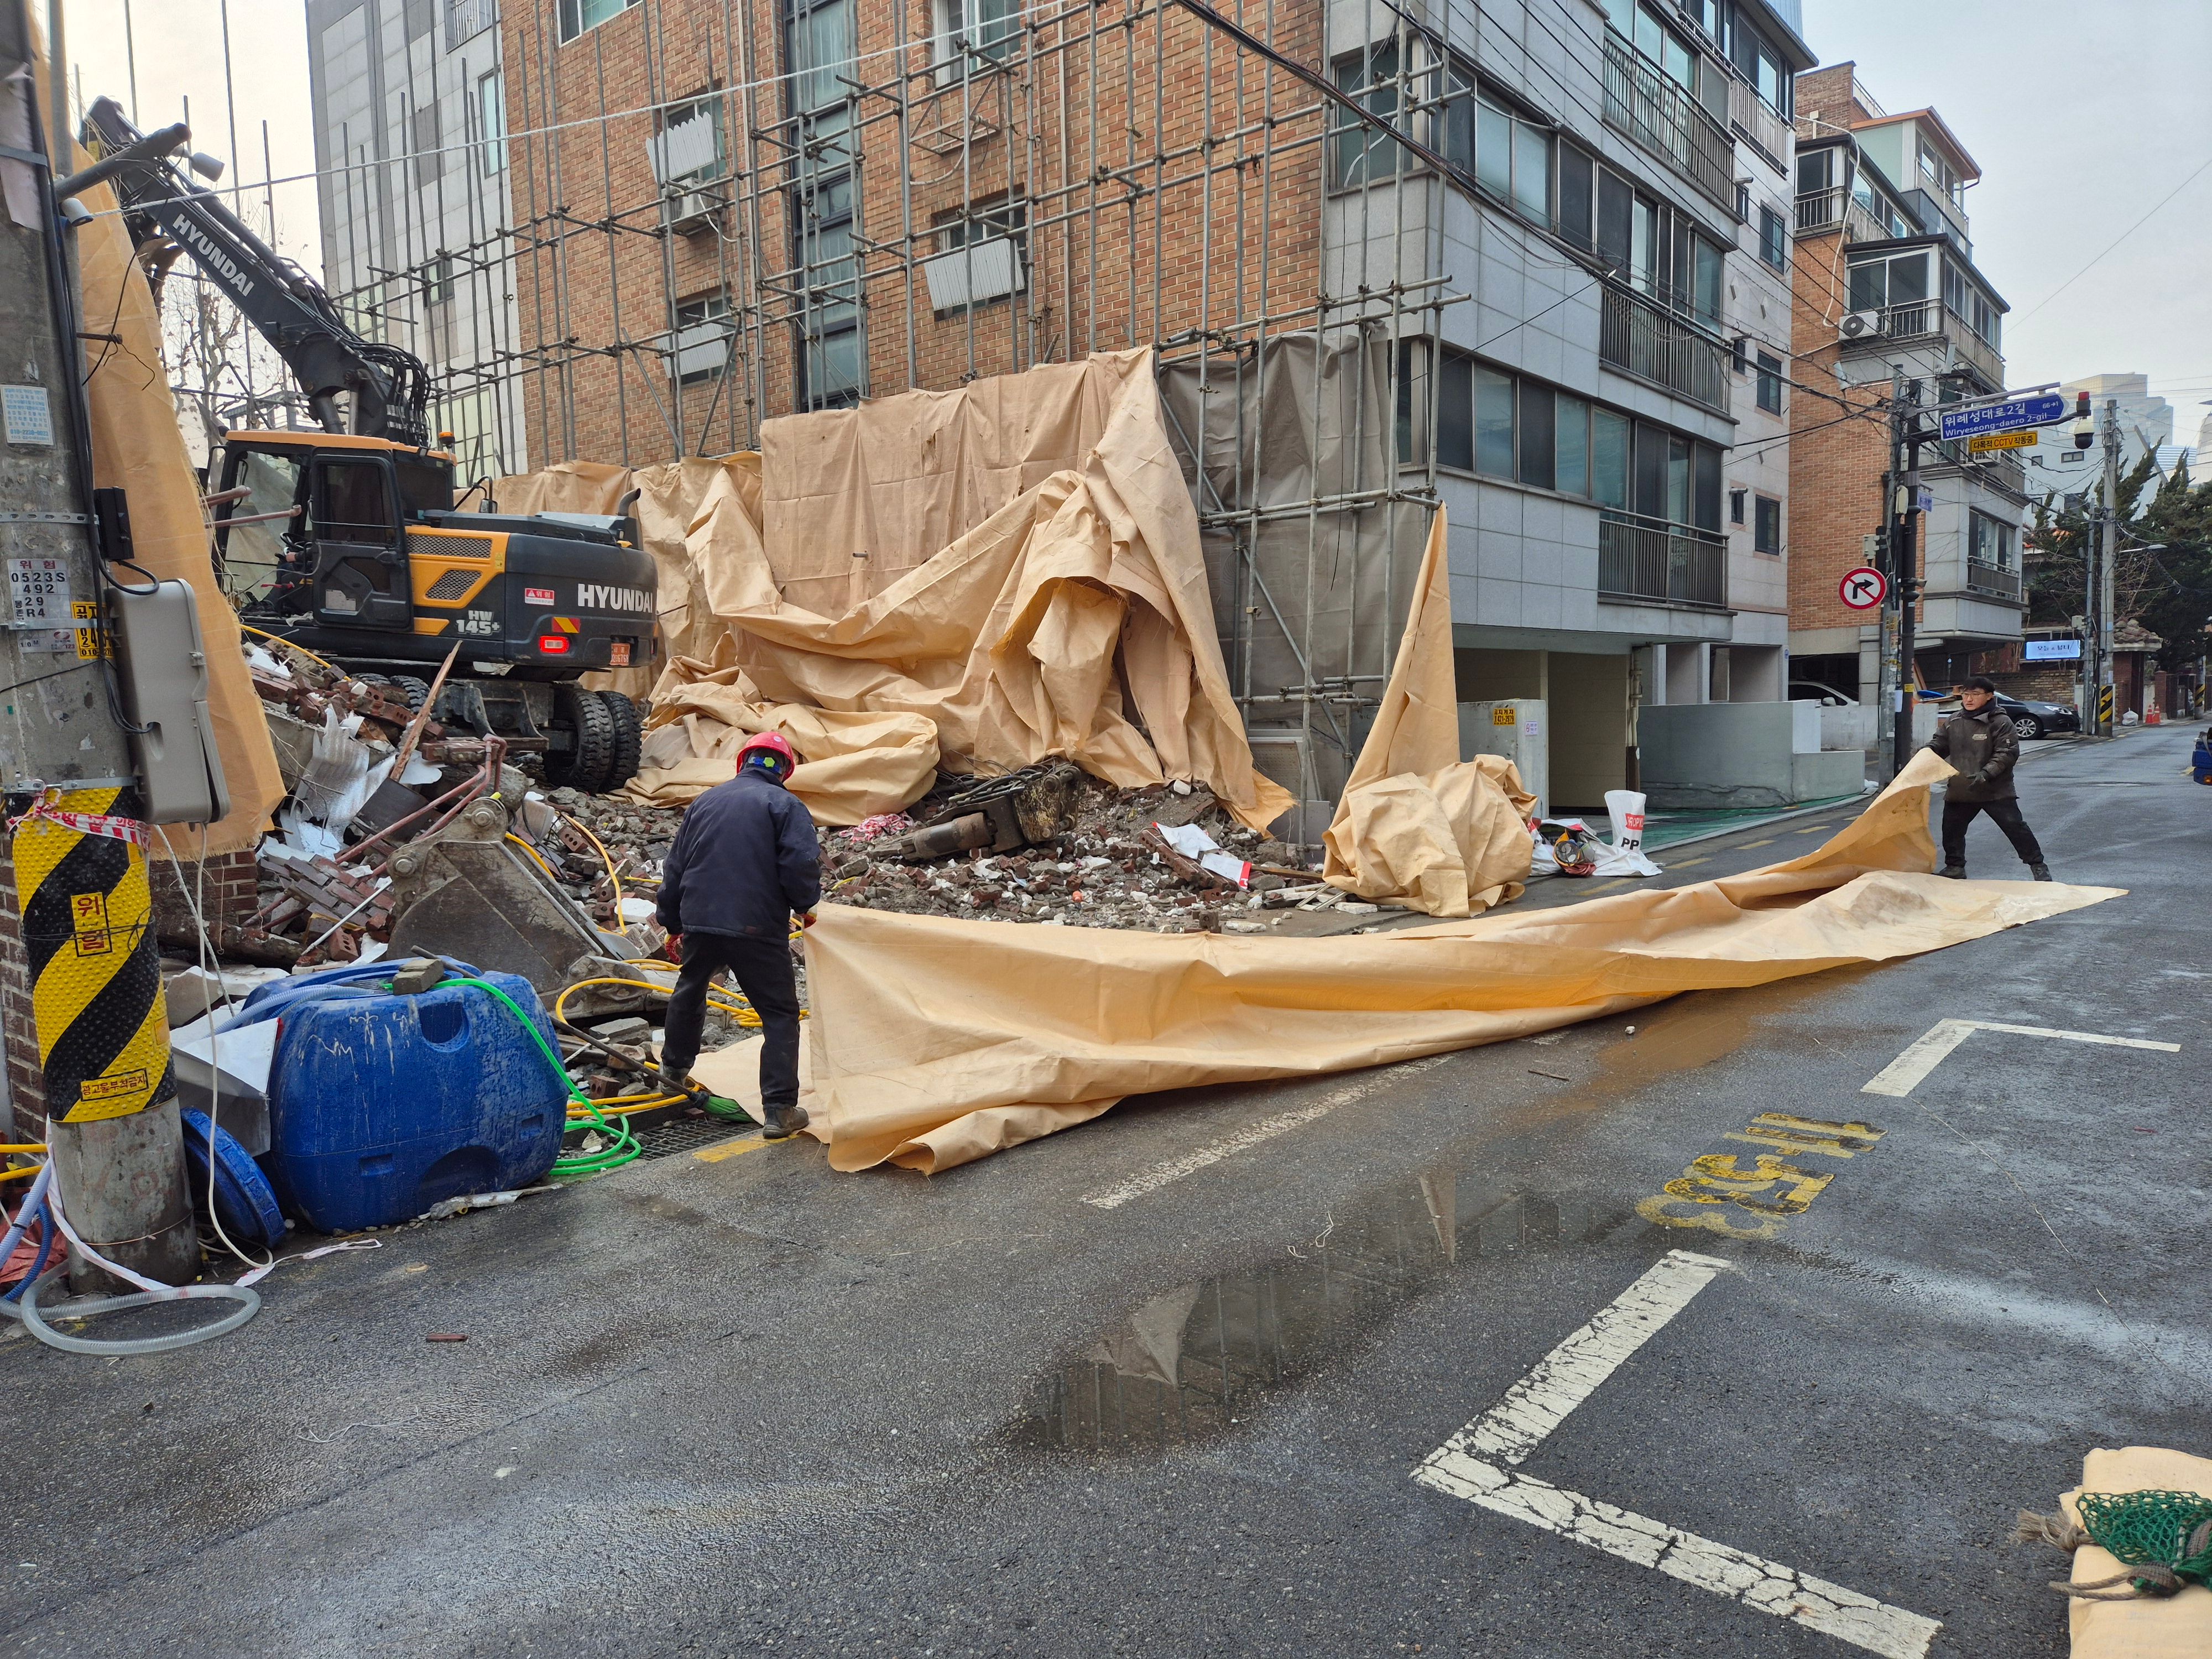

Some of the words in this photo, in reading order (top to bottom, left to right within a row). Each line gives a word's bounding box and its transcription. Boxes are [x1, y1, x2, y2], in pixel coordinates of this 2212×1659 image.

[173, 213, 254, 296] HYUNDAI
[1945, 402, 2026, 427] 위례성대로2길
[1945, 418, 2024, 436] Wiryeseong-daero
[2027, 412, 2047, 422] 2-gil
[1974, 439, 1992, 448] 다목적
[1994, 438, 2013, 447] CCTV
[2014, 435, 2034, 445] 작동중
[20, 560, 55, 569] 위험
[11, 572, 65, 582] 0523S
[23, 584, 54, 593] 492
[25, 597, 44, 606] 29
[578, 583, 653, 613] HYUNDAI
[27, 608, 45, 617] R4
[468, 610, 493, 621] HW
[456, 619, 500, 634] 145+
[1621, 837, 1640, 851] PP
[77, 895, 105, 951] 위험
